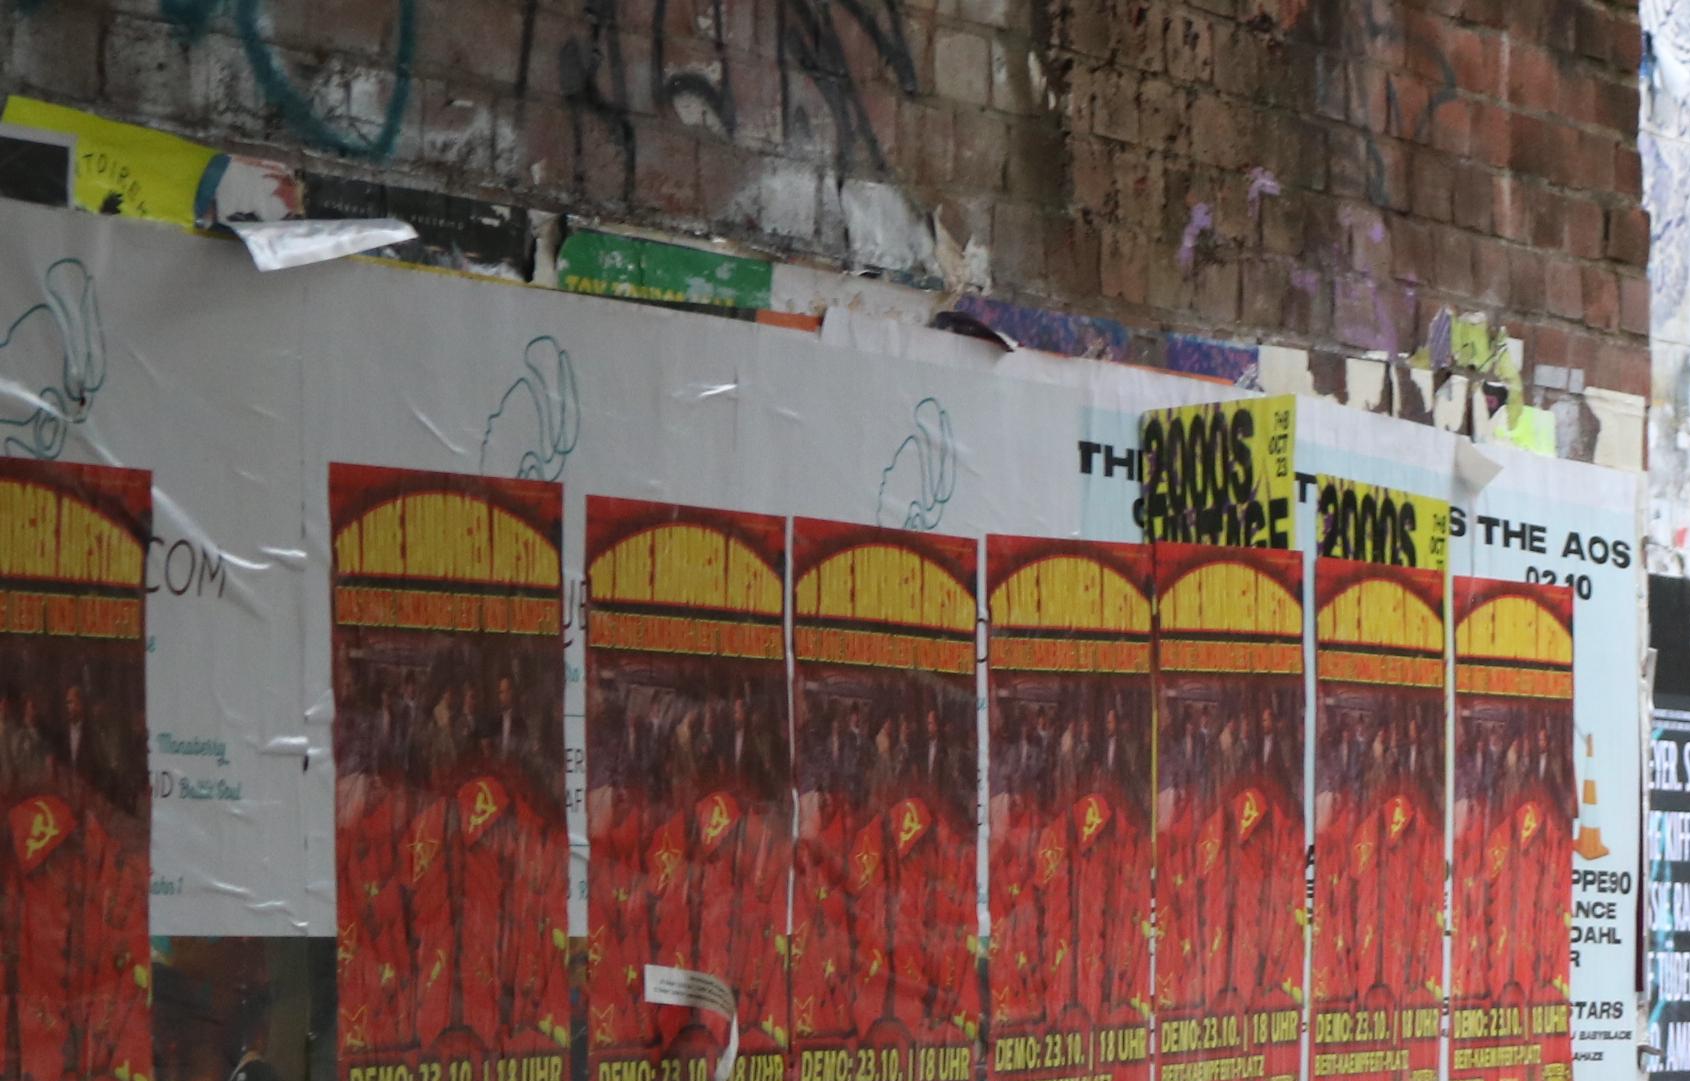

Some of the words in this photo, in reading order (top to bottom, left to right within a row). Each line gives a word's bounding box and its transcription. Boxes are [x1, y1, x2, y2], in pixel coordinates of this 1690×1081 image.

[1478, 514, 1547, 554] THE
[1562, 531, 1631, 570] AOS
[994, 1036, 1041, 1072] DEMO:
[1044, 1033, 1085, 1068] 23.10.
[1100, 1029, 1115, 1063] 18
[1118, 1027, 1146, 1061] UHR
[1161, 1019, 1200, 1053] DEMO:
[1203, 1016, 1240, 1049] 23.10.
[1254, 1012, 1268, 1044] 18
[1271, 1010, 1299, 1042] UHR
[919, 1047, 935, 1081] 18
[938, 1047, 970, 1081] UHR
